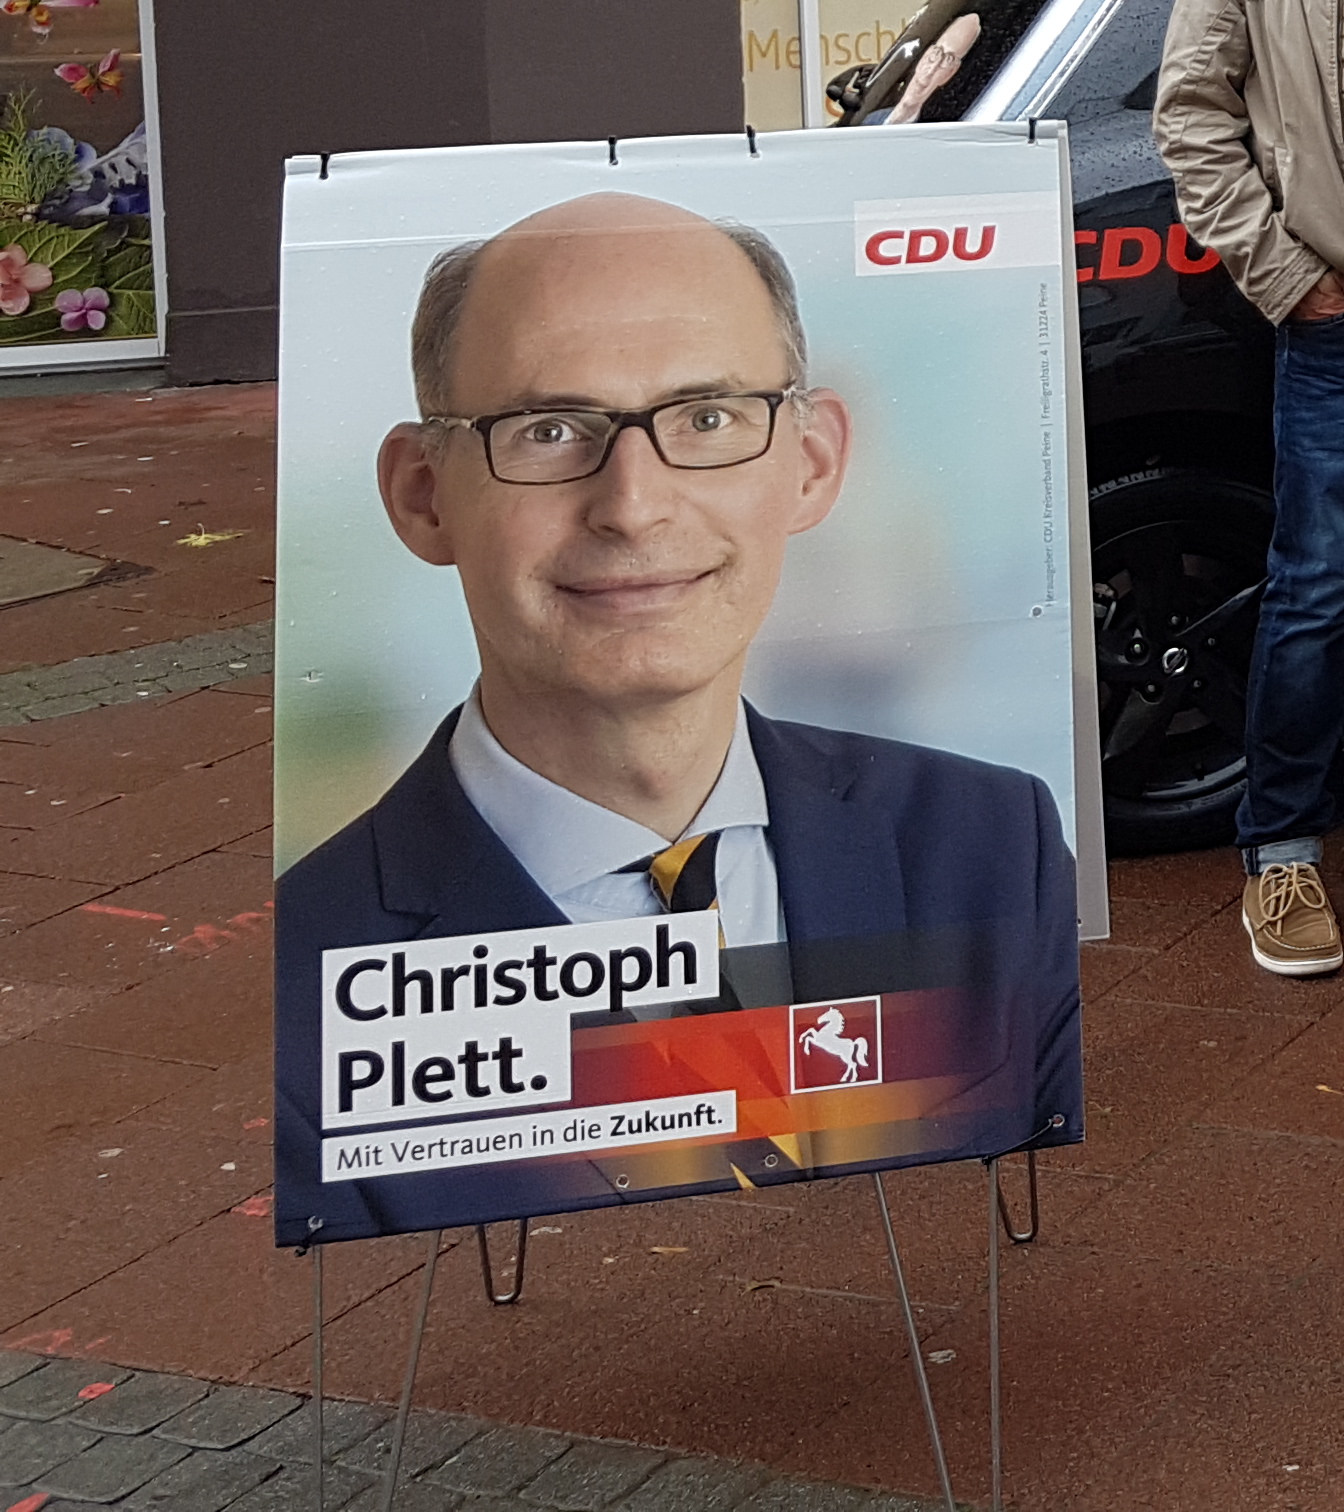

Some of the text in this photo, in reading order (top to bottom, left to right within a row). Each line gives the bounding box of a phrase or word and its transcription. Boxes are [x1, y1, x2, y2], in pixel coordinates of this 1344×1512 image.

[865, 225, 996, 266] CDU
[1038, 309, 1049, 338] 31224
[1040, 432, 1052, 458] Peine
[1042, 520, 1053, 544] CDU
[335, 923, 698, 1022] Christoph
[337, 1036, 549, 1114] Plett.
[336, 1103, 723, 1171] Mit Vertrauen in die Zukunft.
